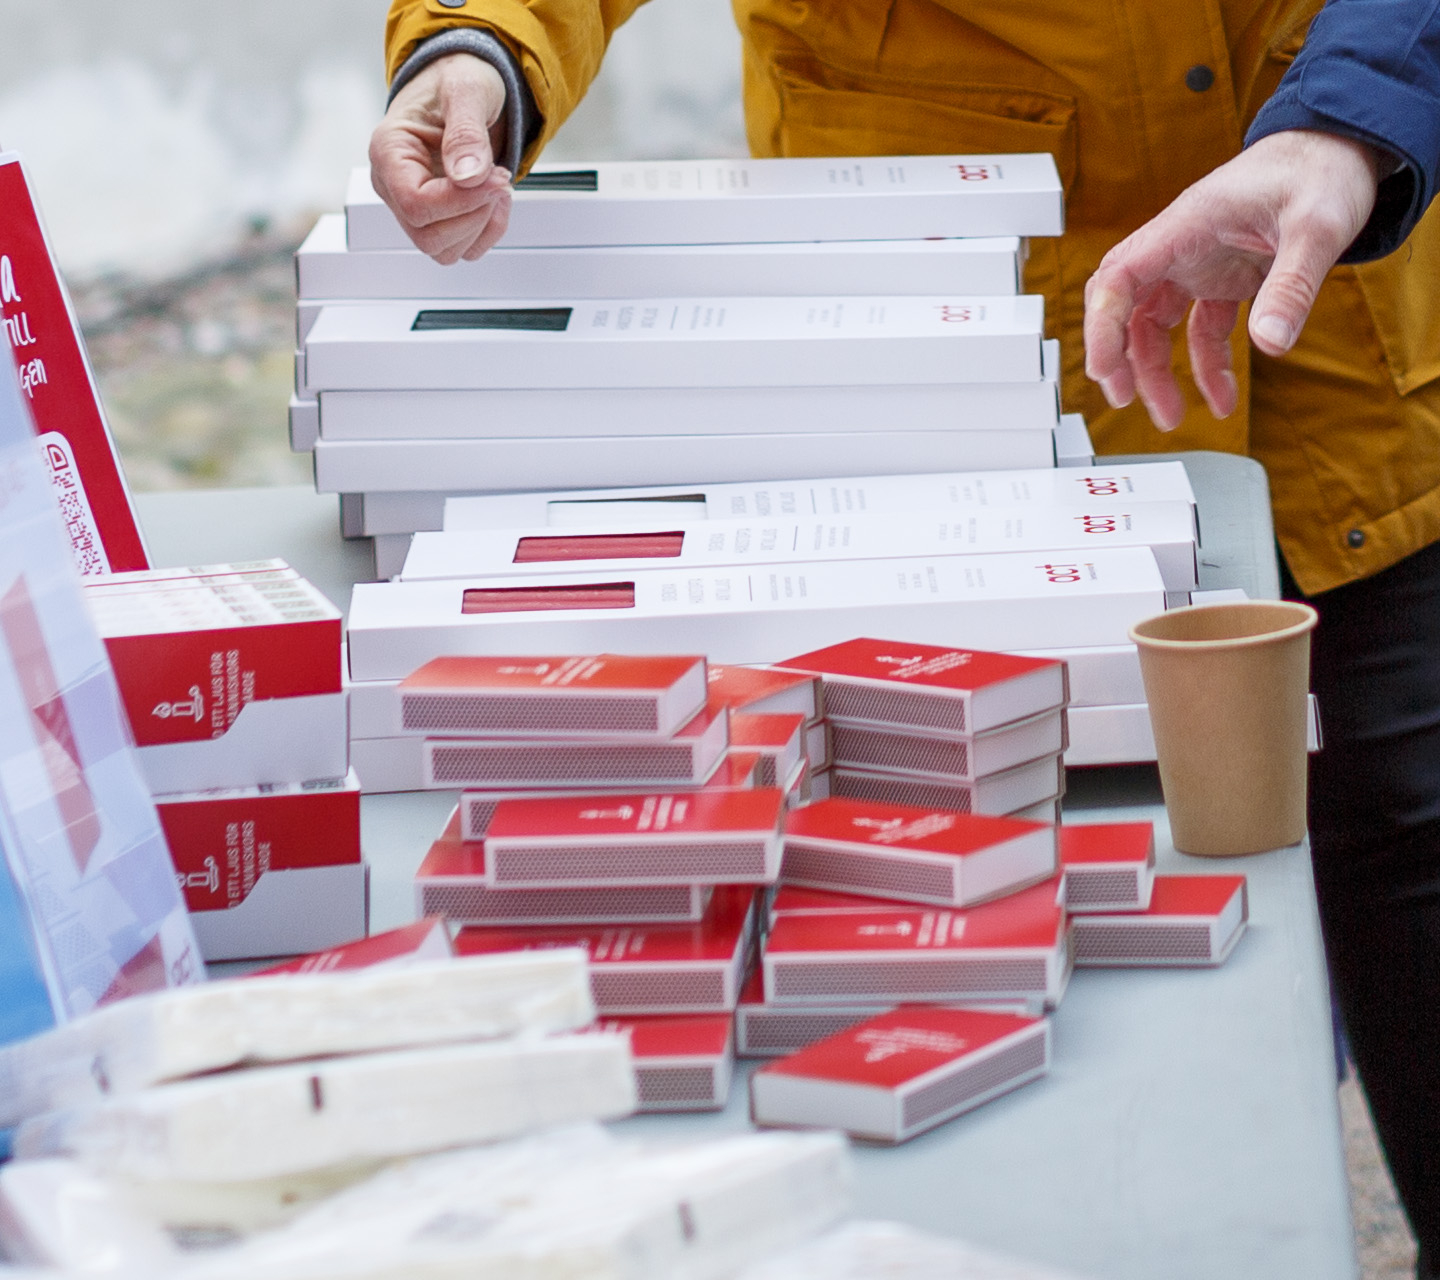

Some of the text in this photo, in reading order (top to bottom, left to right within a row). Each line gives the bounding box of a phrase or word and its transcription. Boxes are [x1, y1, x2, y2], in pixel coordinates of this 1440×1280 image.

[1075, 477, 1119, 495] act
[1073, 515, 1116, 533] act
[1034, 563, 1081, 583] act
[211, 676, 225, 707] LJUS
[211, 708, 225, 728] ETT
[226, 848, 240, 878] LJUS
